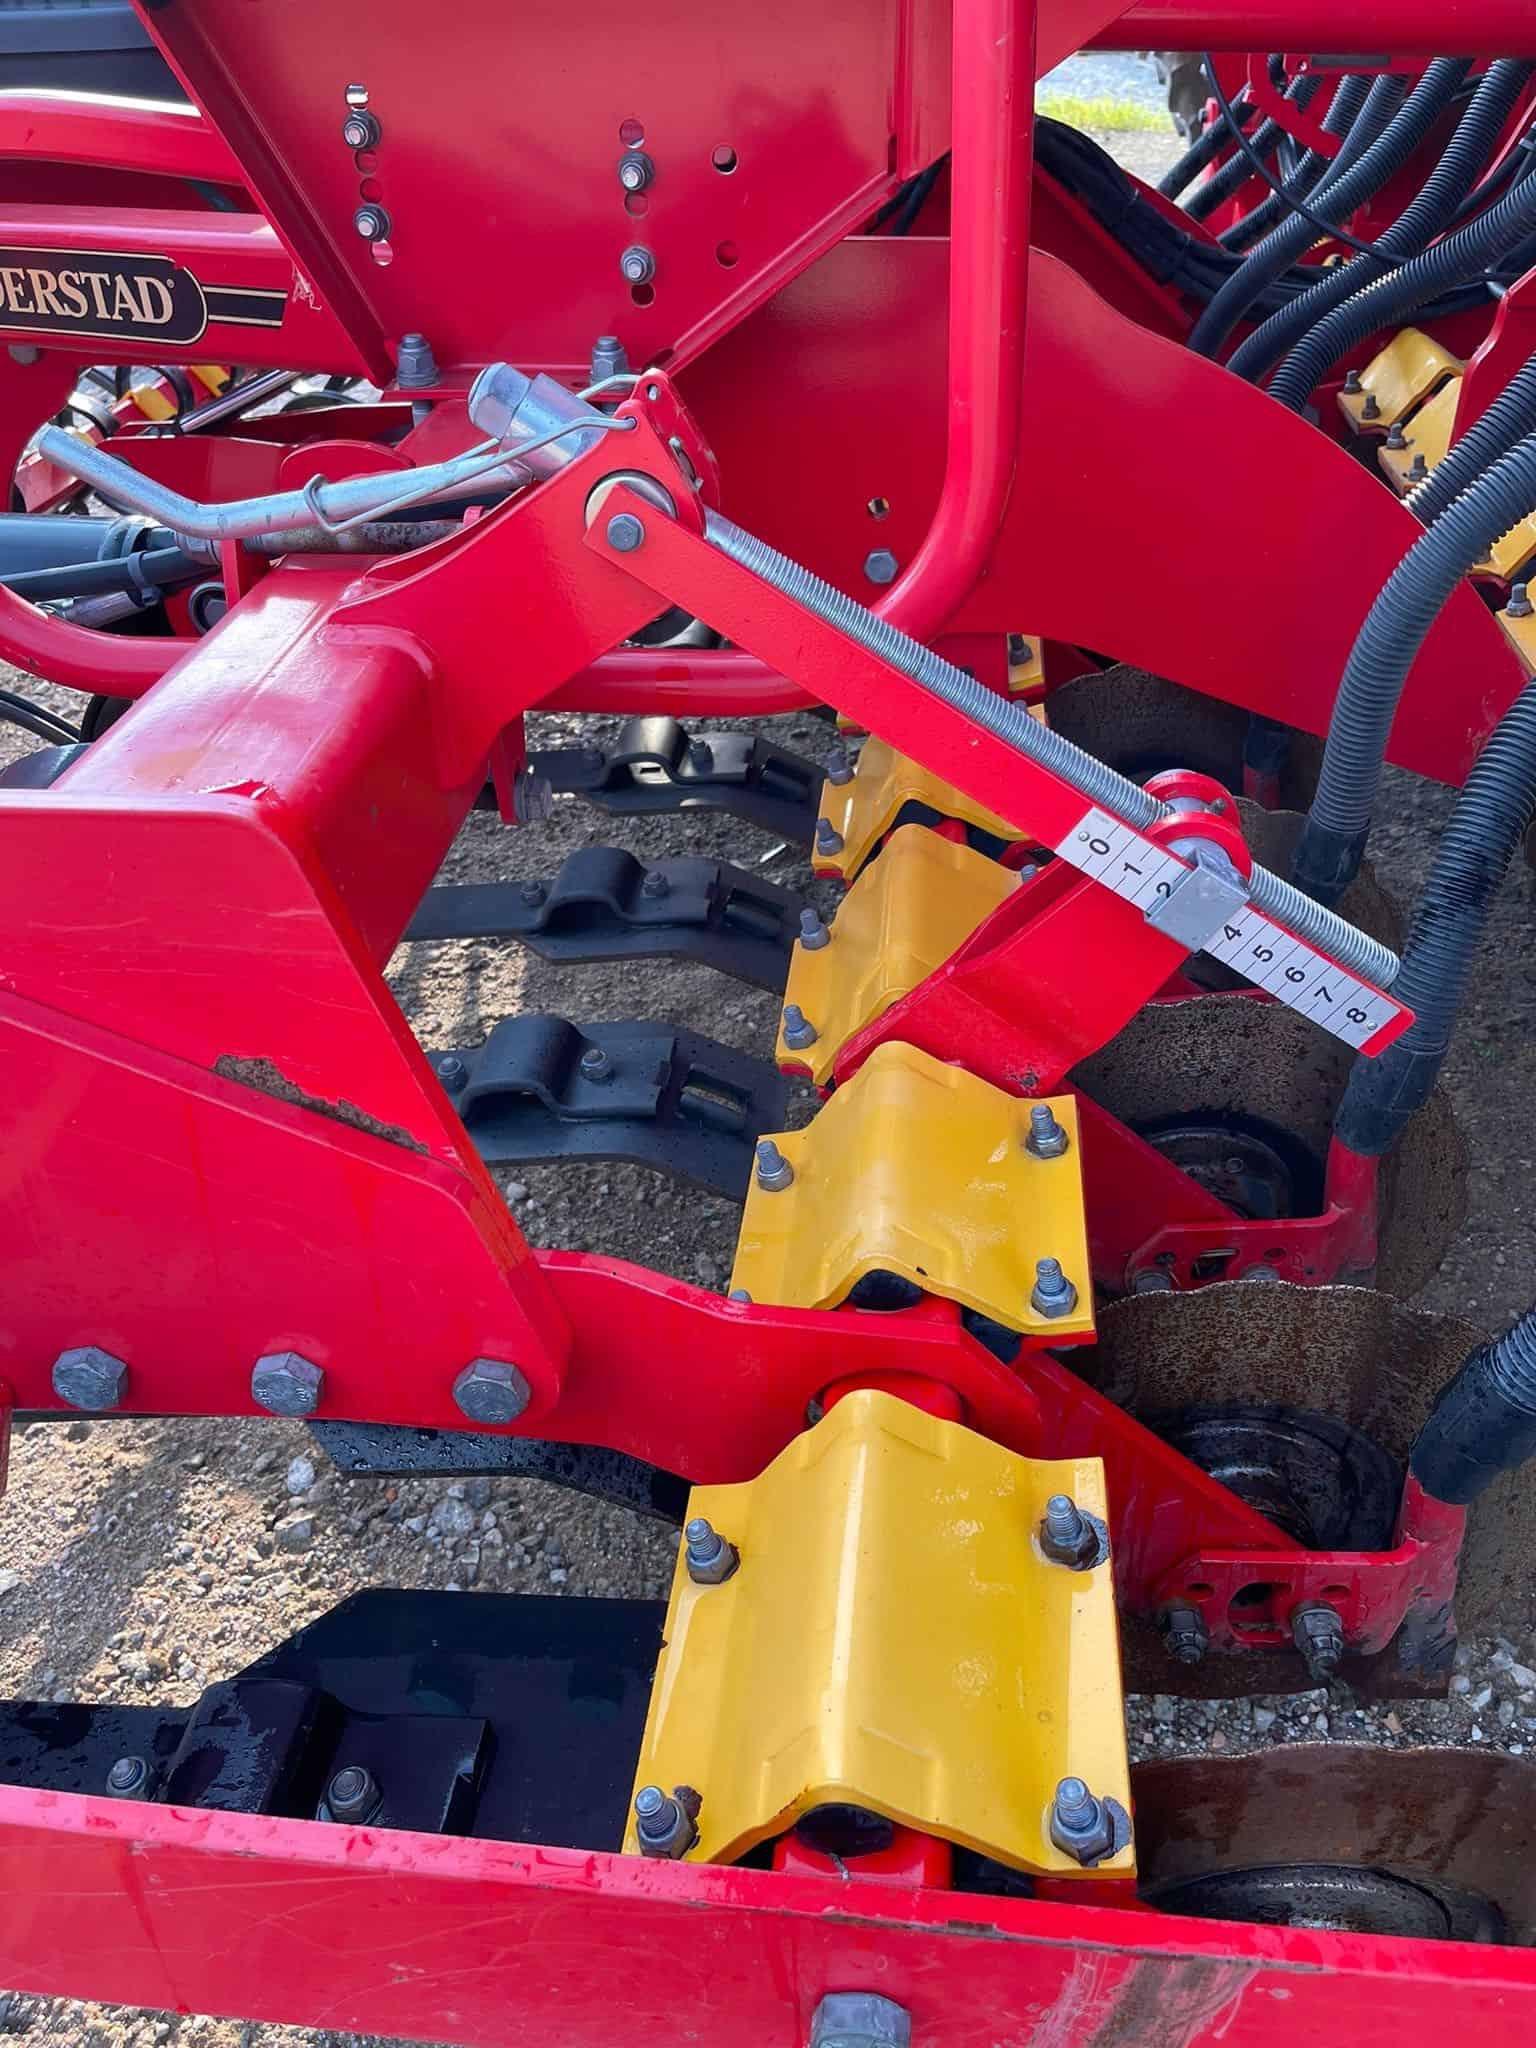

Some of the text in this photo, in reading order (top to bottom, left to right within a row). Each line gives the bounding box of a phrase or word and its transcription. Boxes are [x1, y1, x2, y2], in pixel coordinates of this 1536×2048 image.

[0, 267, 174, 325] ERSTAD
[1089, 838, 1110, 855] 0
[1123, 862, 1143, 876] 1
[1156, 881, 1172, 899] 2
[1223, 924, 1243, 941] 4
[1252, 945, 1274, 962] 5
[1285, 966, 1306, 983] 6
[1314, 986, 1333, 1003] 7
[1346, 1007, 1367, 1024] 8
